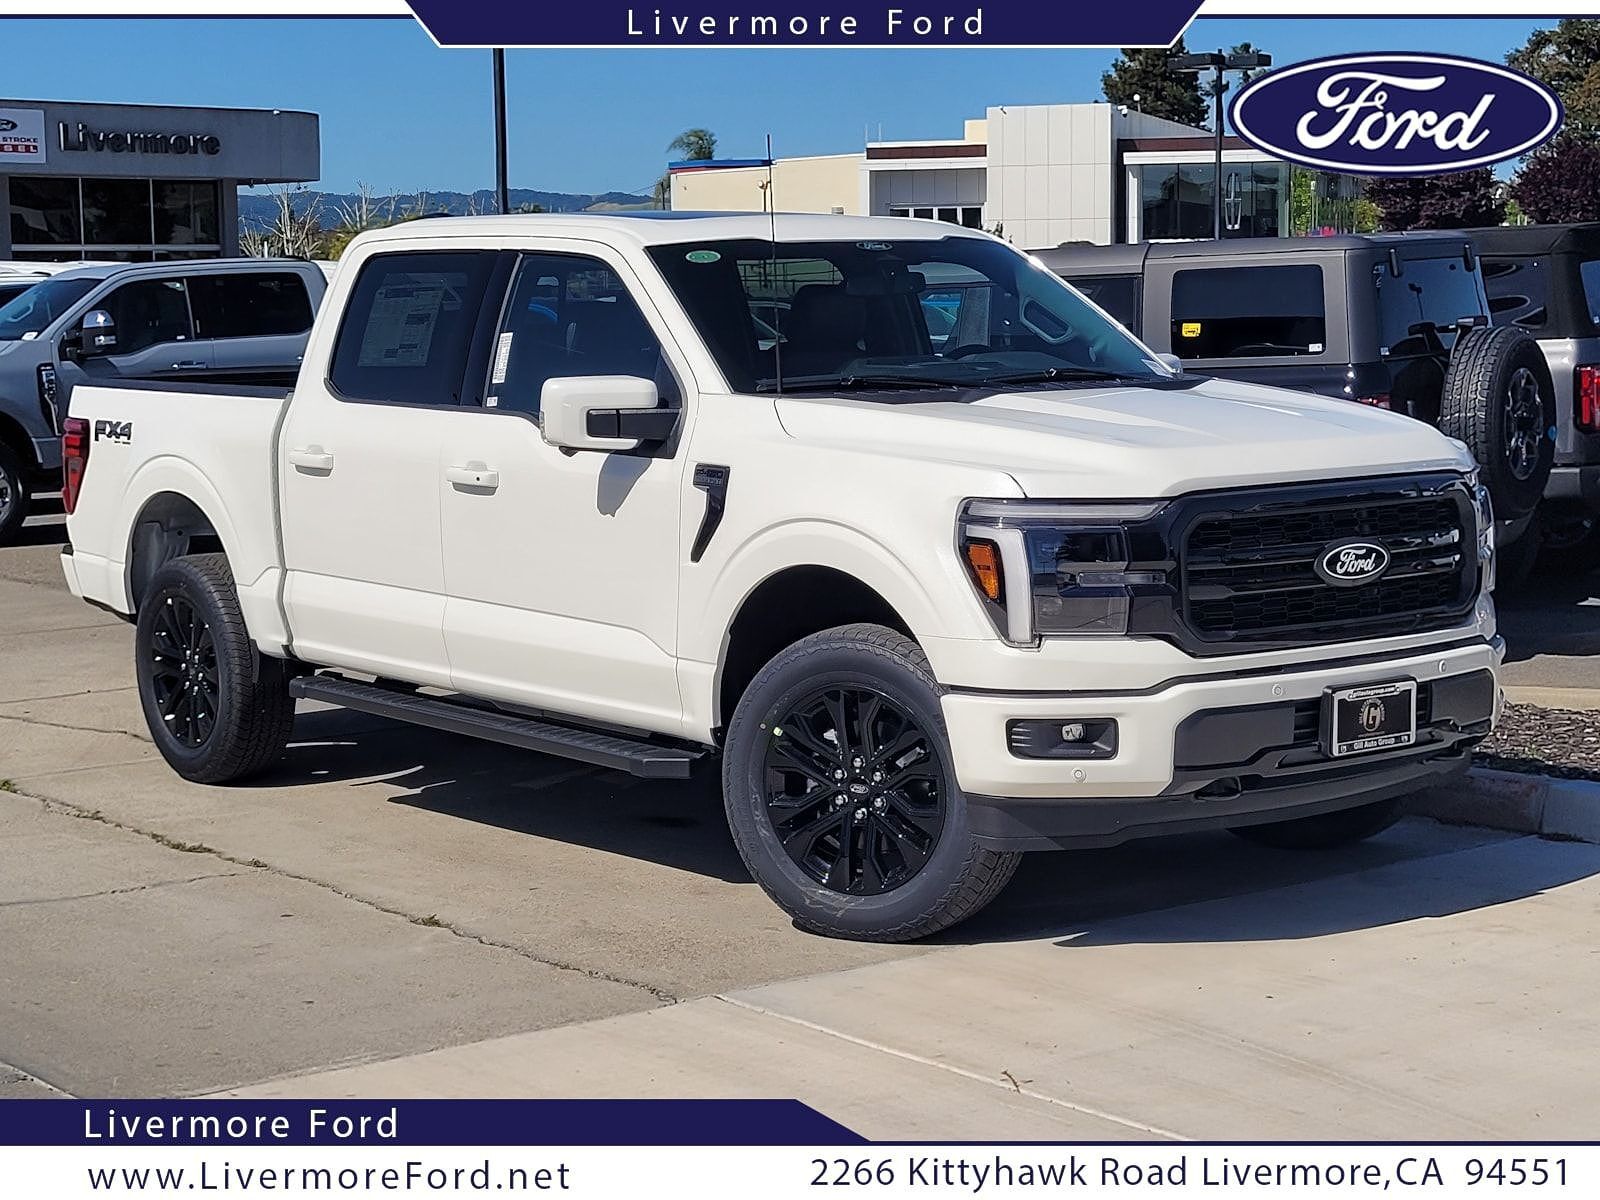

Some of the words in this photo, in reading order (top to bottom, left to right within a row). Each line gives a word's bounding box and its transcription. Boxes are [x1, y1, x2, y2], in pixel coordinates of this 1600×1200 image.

[58, 121, 221, 156] Livermore
[94, 419, 133, 441] FX4
[1335, 547, 1377, 574] Ford
[1353, 741, 1364, 750] Gill
[1364, 740, 1378, 749] Auto
[1378, 737, 1395, 747] Group
